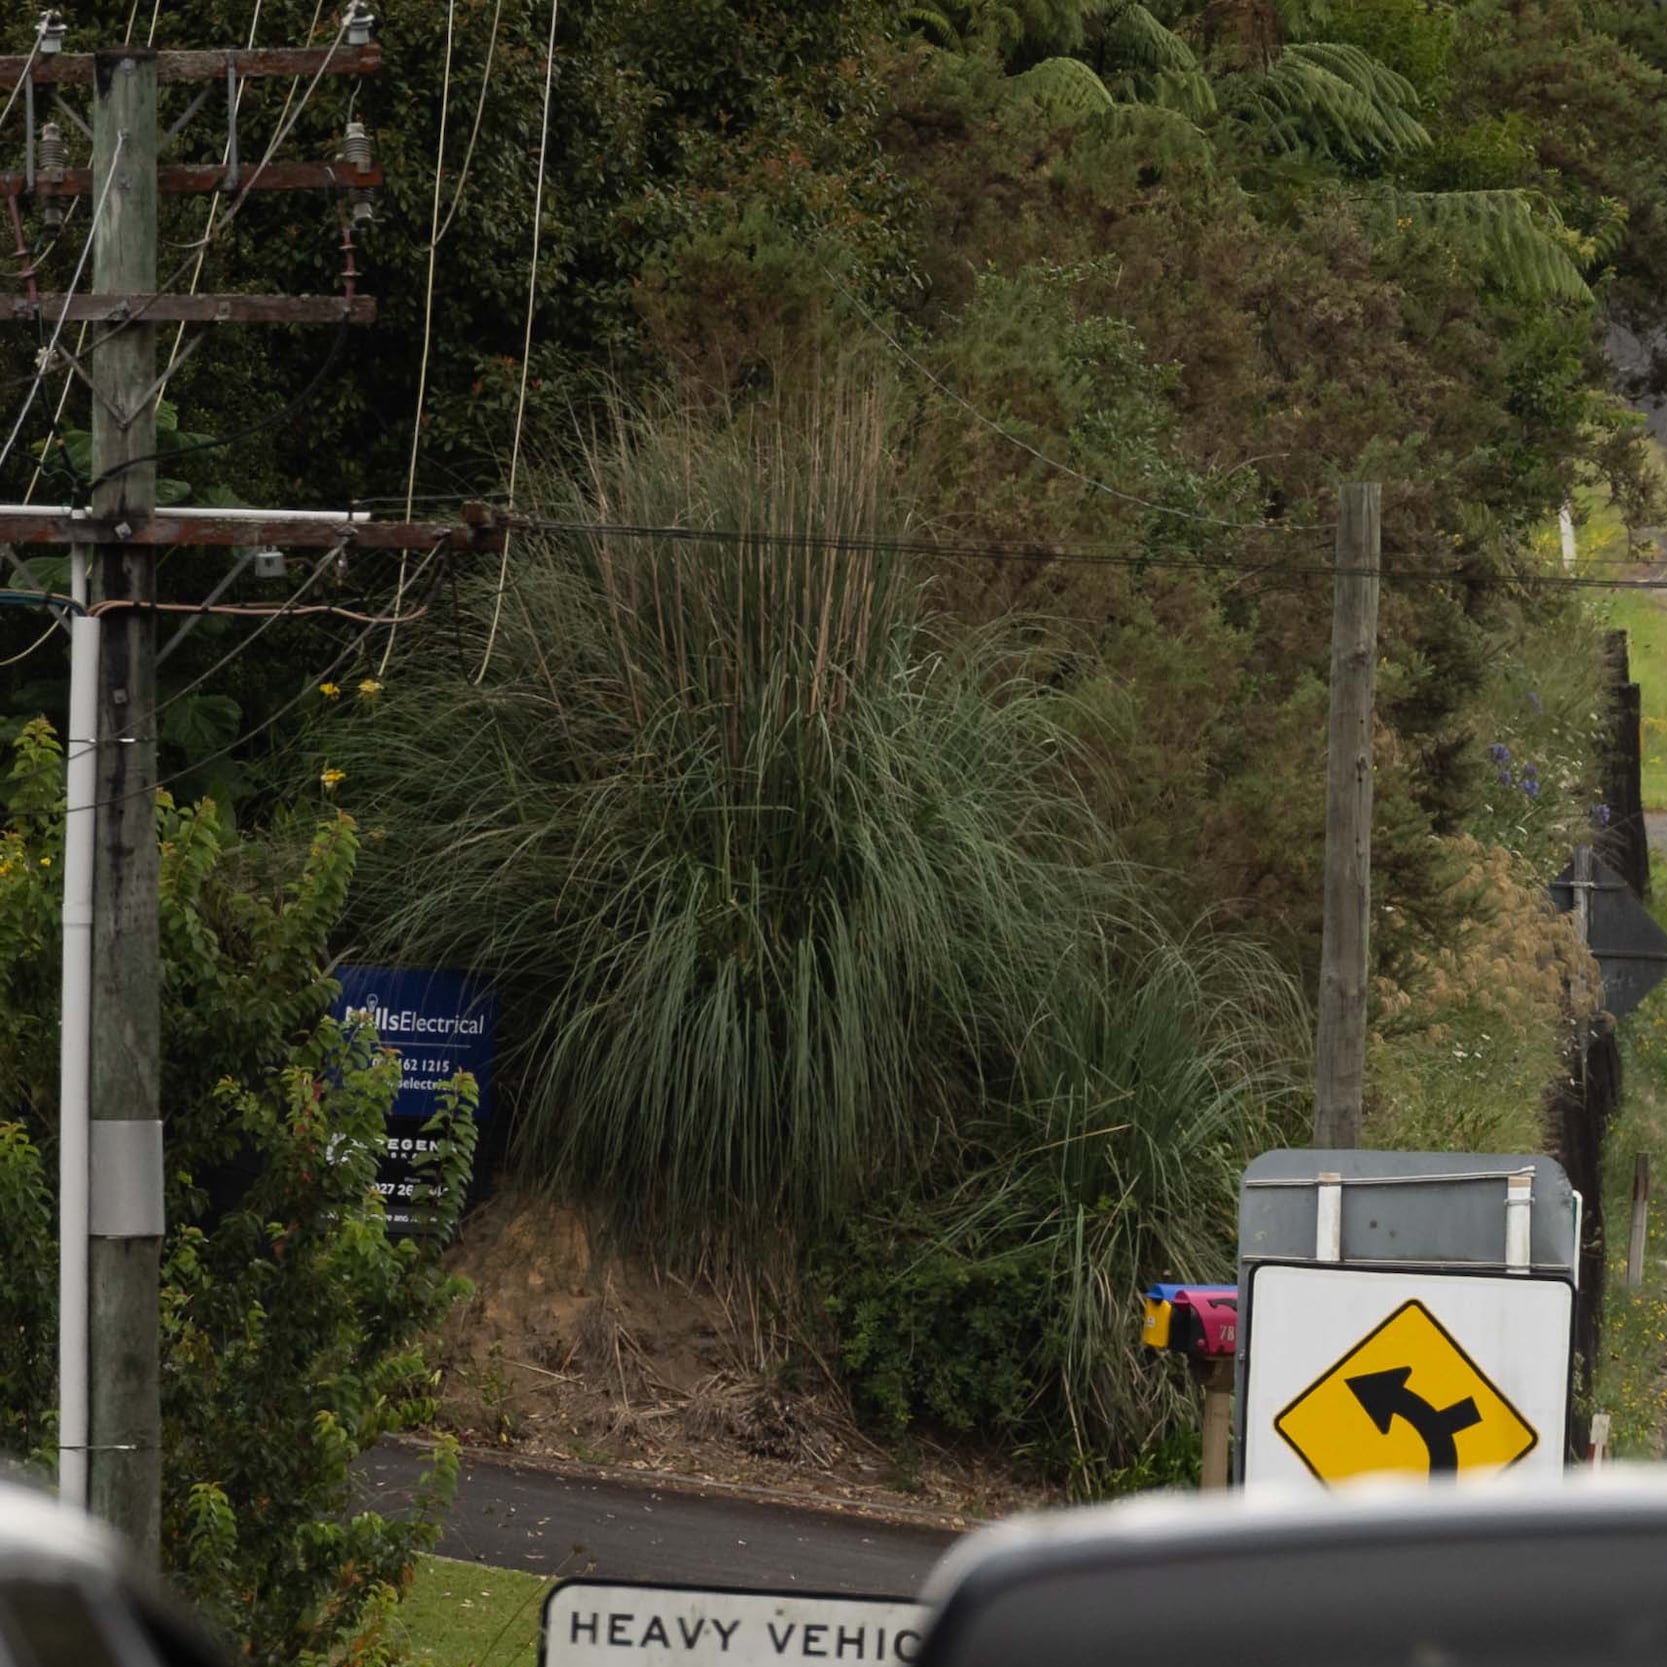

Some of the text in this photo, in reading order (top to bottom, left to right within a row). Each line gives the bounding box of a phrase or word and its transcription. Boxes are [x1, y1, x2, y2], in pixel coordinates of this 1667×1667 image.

[422, 1059, 450, 1073] 1215
[569, 1610, 922, 1665] HEAVY VEHIC
